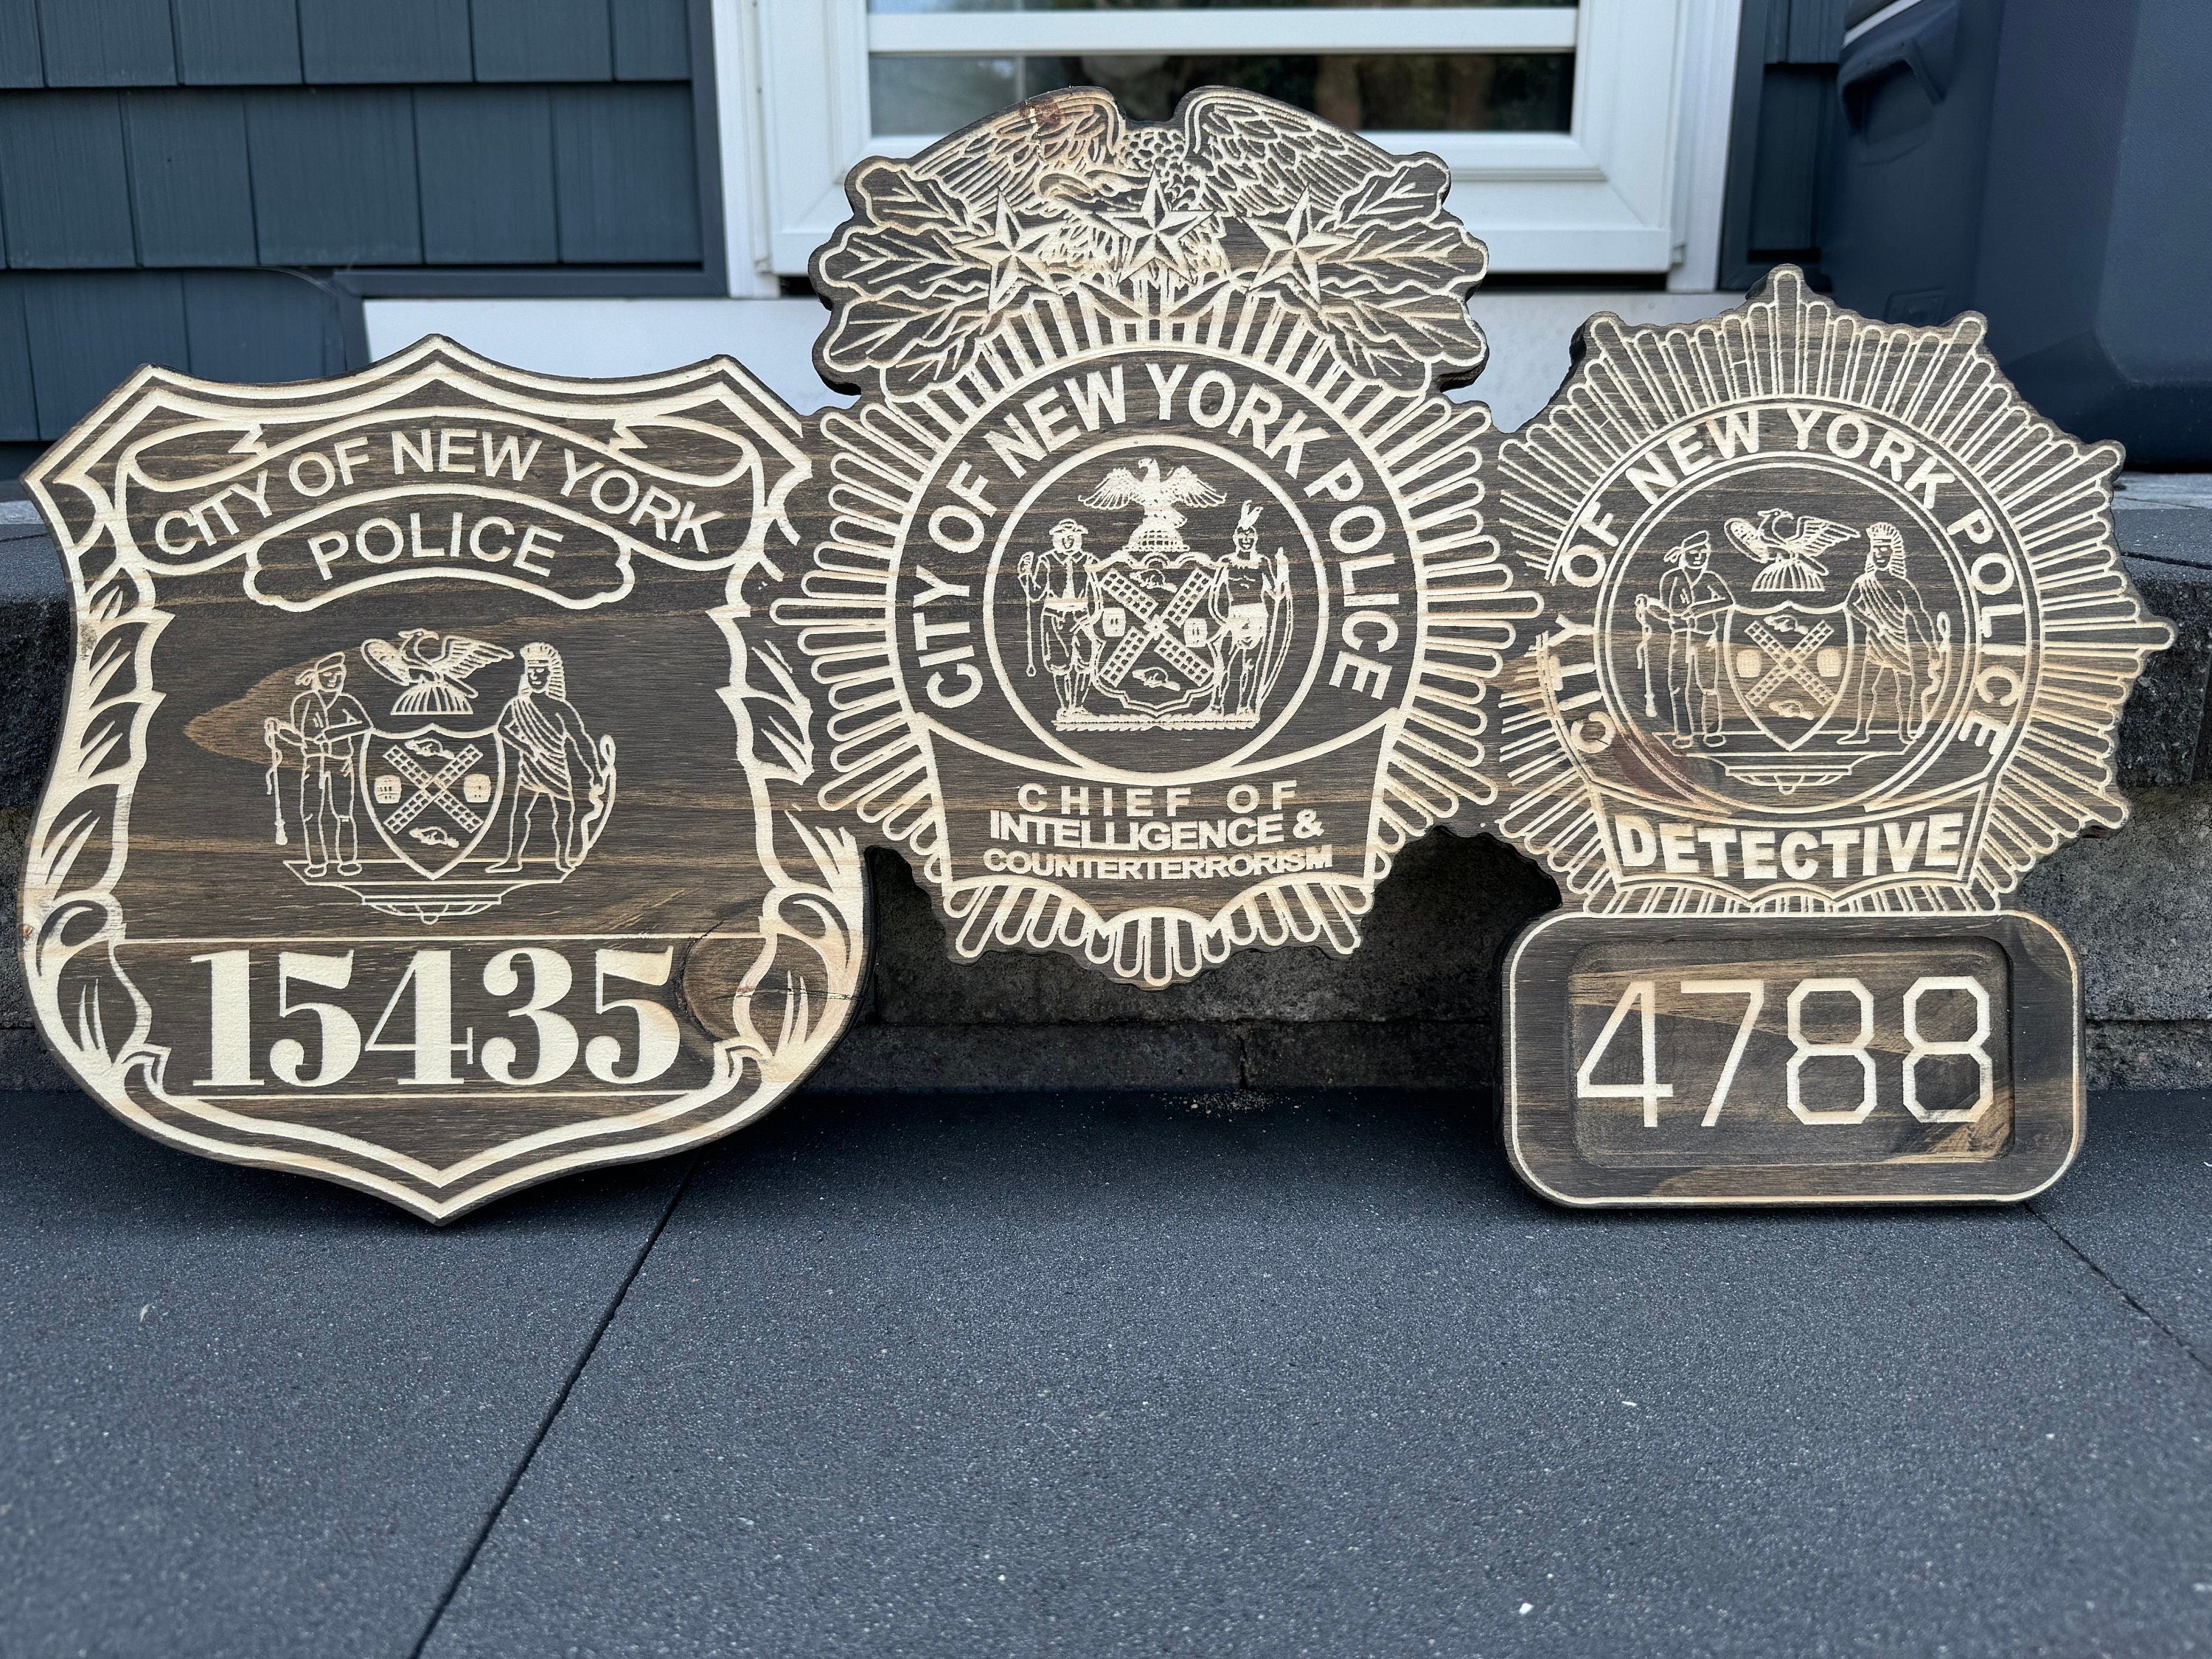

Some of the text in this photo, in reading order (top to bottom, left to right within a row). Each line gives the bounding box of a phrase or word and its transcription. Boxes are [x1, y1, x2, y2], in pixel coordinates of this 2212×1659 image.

[154, 429, 728, 557] CITY OF NEW YORK
[914, 364, 1400, 709] CITY OF NEW YORK POLICE
[310, 512, 564, 581] POLICE
[1547, 406, 2026, 755] CITY OF NEW YORK POLICE
[991, 808, 1324, 850] INTELLIGENCE &
[1018, 781, 1298, 815] CHIEF OF
[1614, 814, 1964, 880] DETECTIVE
[983, 846, 1332, 880] COUNTERTERRORISM
[191, 947, 681, 1086] 15435
[1576, 975, 1992, 1128] 4788
